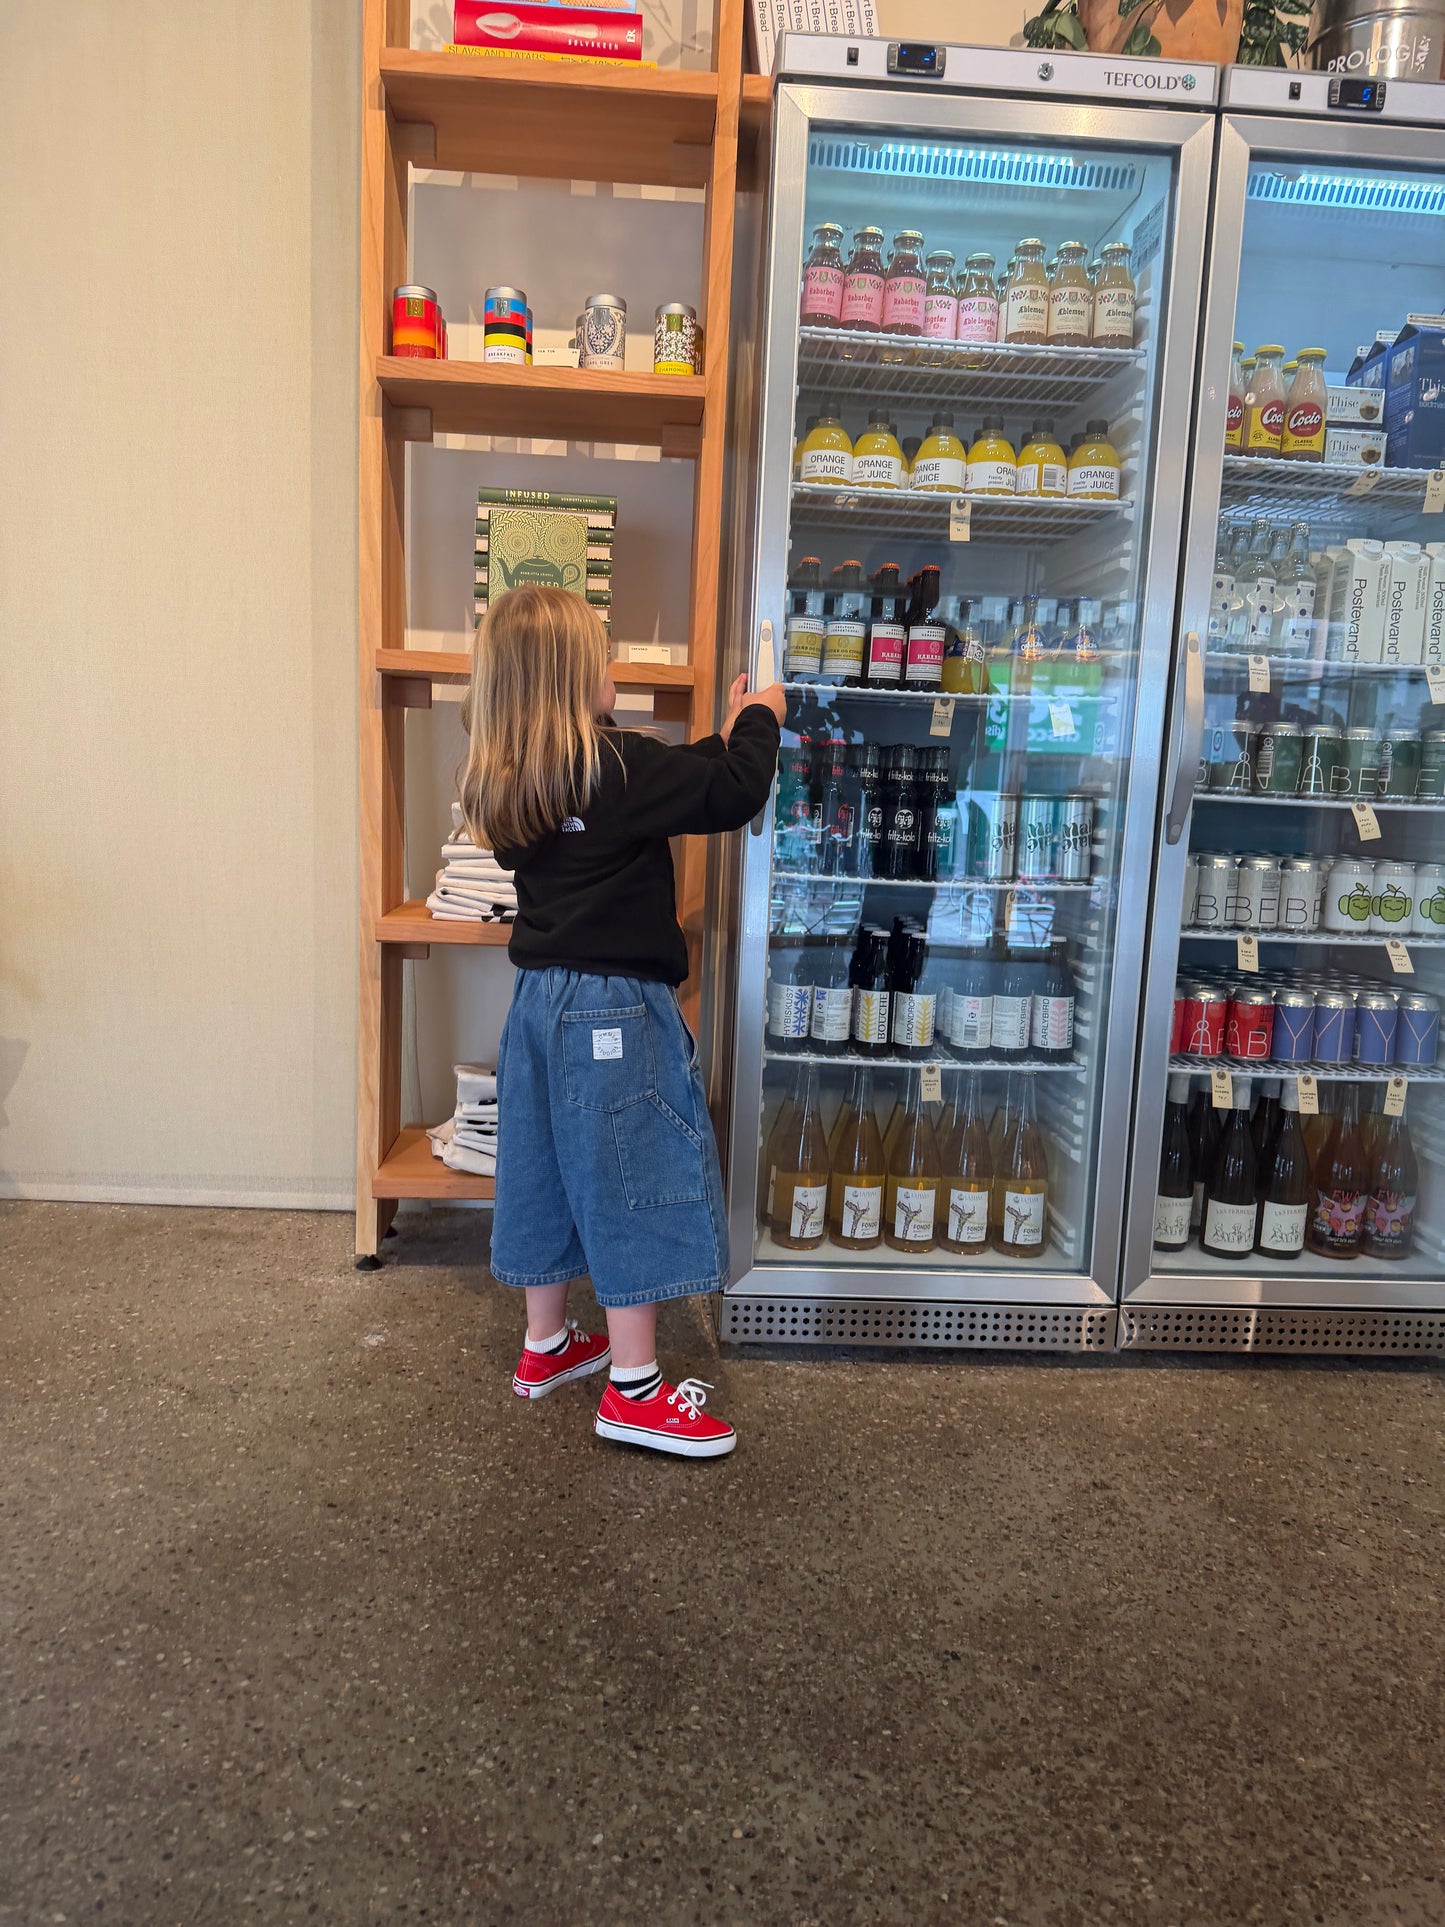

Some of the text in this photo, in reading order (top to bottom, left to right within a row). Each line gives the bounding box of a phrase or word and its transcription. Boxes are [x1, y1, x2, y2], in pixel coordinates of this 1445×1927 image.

[758, 2, 770, 32] Bread
[776, 4, 785, 28] Brea
[794, 6, 803, 31] Brea
[812, 7, 821, 32] Brea
[830, 8, 839, 32] Brea
[847, 10, 855, 35] Brea
[865, 10, 874, 36] Brea
[484, 48, 506, 57] AND
[1327, 43, 1410, 73] PROLOG
[1103, 71, 1178, 91] TEFCOLD
[1419, 377, 1445, 391] This
[1290, 409, 1322, 429] Cocio
[811, 454, 845, 465] ORANGE
[820, 464, 845, 475] JUICE
[858, 459, 893, 470] ORANGE
[914, 462, 940, 472] RANGE
[867, 470, 892, 480] JUICE
[916, 473, 940, 484] JUICE
[1079, 470, 1115, 480] ORANGE
[1089, 481, 1115, 490] JUICE
[505, 489, 550, 500] INFUSED
[1346, 578, 1367, 653] Postevand
[1387, 581, 1406, 655] Postevand
[1429, 581, 1445, 655] Postevand
[877, 993, 888, 1041] BOUCHE
[906, 995, 916, 1045] LEMONDROP
[1018, 998, 1028, 1047] EARLYBIRD
[1040, 998, 1050, 1047] EARLYBIRD
